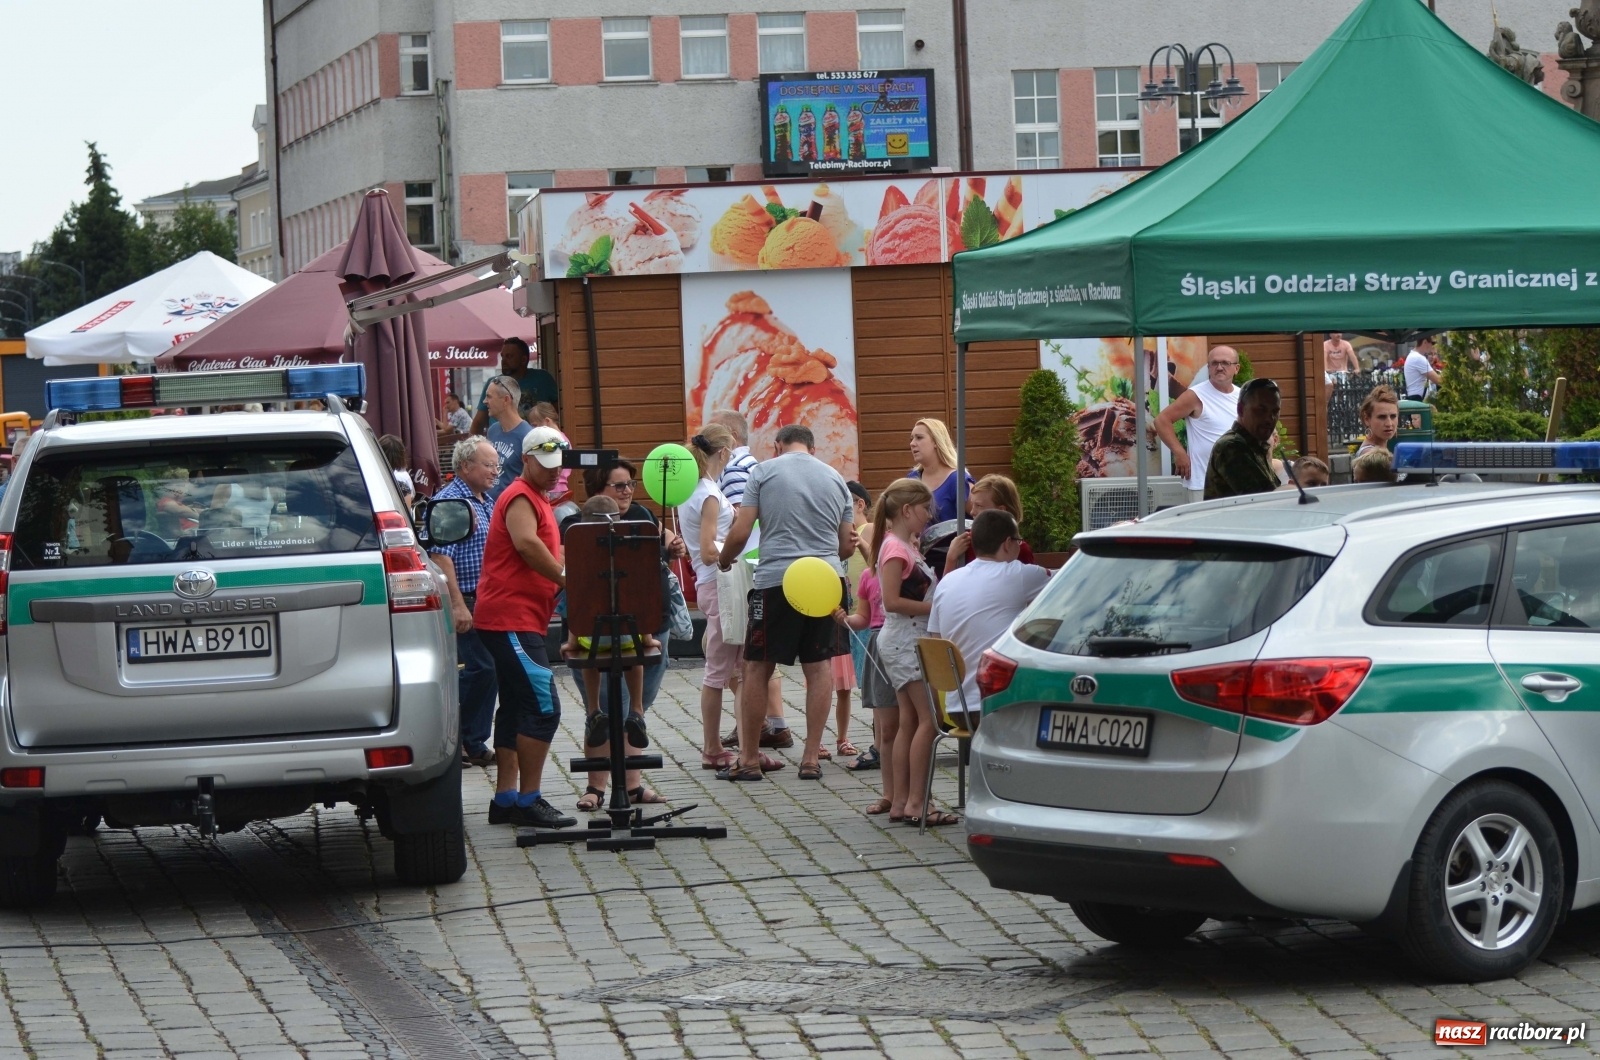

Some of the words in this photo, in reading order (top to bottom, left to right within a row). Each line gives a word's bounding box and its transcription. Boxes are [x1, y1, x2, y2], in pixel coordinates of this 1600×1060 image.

[847, 71, 862, 79] 355
[779, 84, 841, 96] DOSTĘPNE
[843, 84, 855, 93] W
[857, 82, 915, 93] SKLEPACH
[870, 116, 904, 125] ZALEŻY
[906, 117, 928, 125] NAM
[809, 159, 892, 170] Telebimy-Raciborz.pl
[1181, 273, 1256, 300] Śląski
[1264, 273, 1357, 294] Oddział
[1364, 271, 1442, 294] Straży
[1450, 268, 1578, 291] Granicznej
[1585, 272, 1598, 286] z
[1017, 286, 1049, 308] Granicznej
[1049, 290, 1055, 303] z
[1055, 284, 1082, 306] siedzibą
[1081, 289, 1088, 301] w
[1088, 282, 1121, 301] Raciborzu
[445, 346, 489, 360] Italia
[188, 357, 237, 372] Gelateria
[239, 356, 267, 369] Ciao
[270, 354, 310, 368] Italia
[249, 537, 315, 547] niezawodności
[116, 603, 173, 617] LAND
[180, 597, 278, 614] CRUISER
[144, 629, 197, 655] HWA
[205, 626, 265, 652] B910
[130, 647, 140, 655] PL
[1073, 679, 1093, 693] KIA
[1051, 714, 1089, 745] HWA
